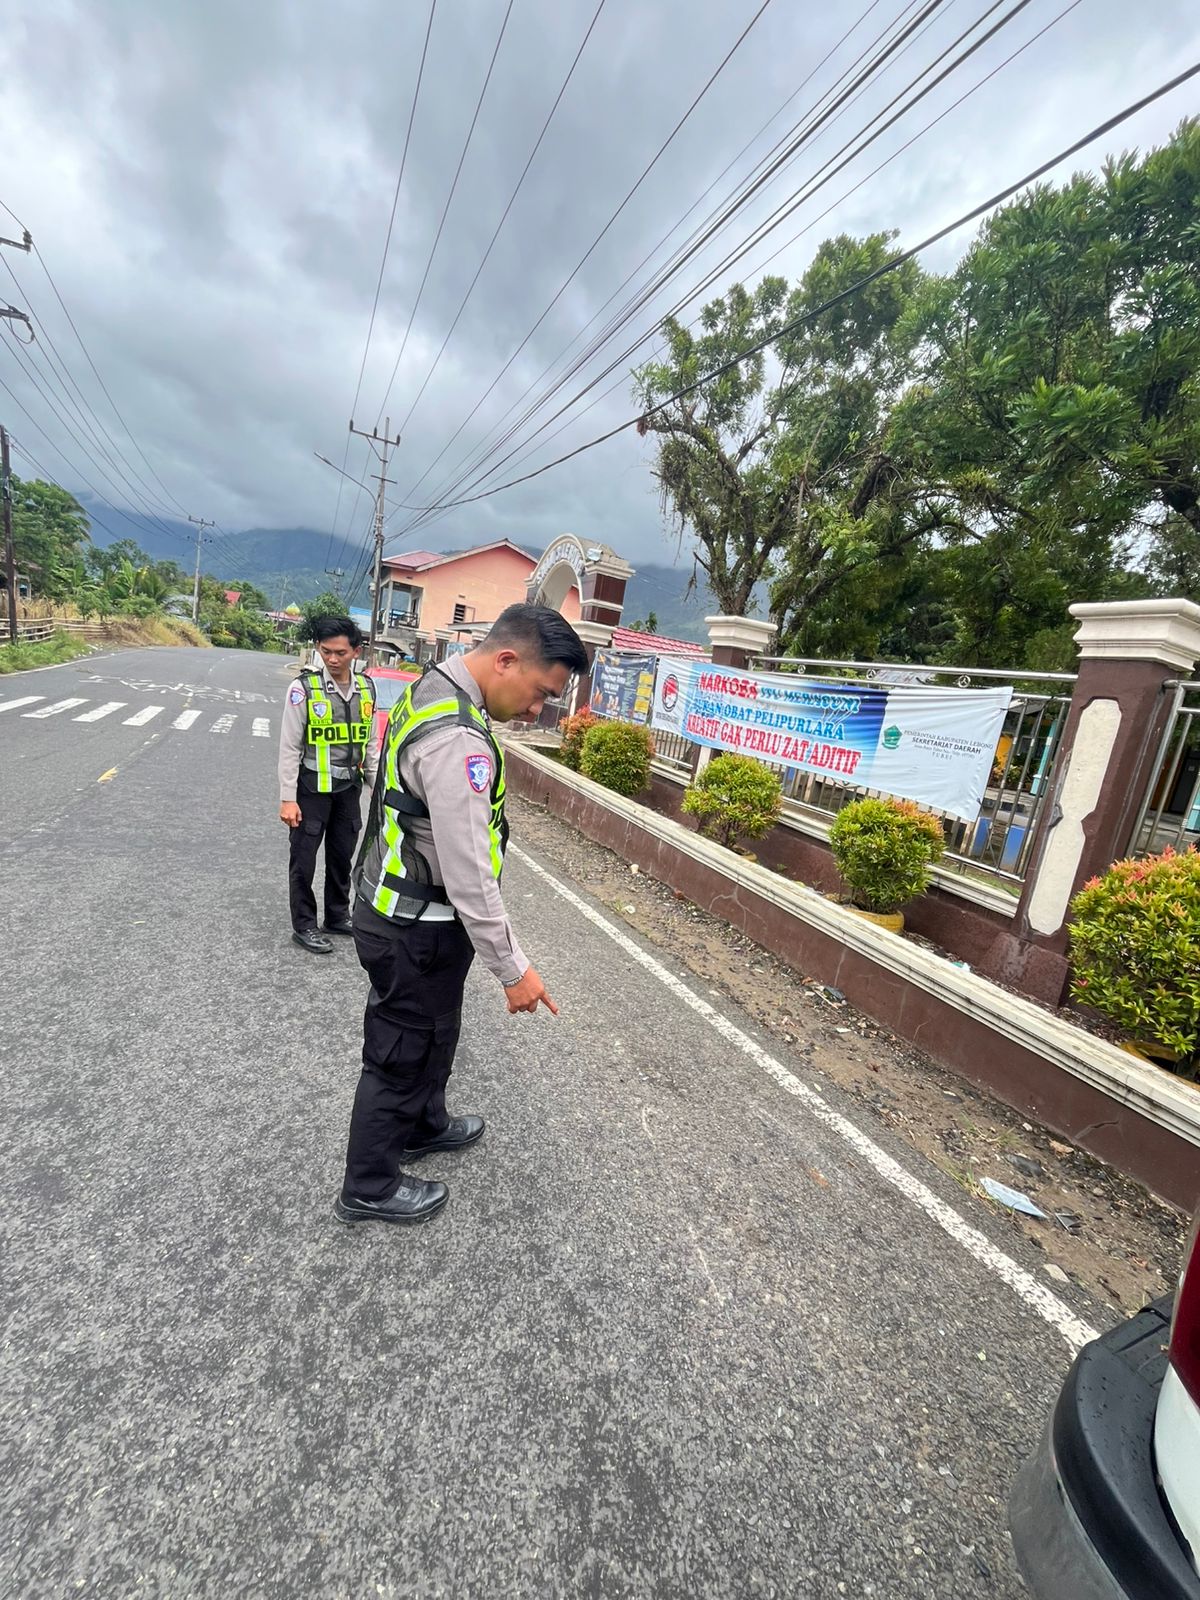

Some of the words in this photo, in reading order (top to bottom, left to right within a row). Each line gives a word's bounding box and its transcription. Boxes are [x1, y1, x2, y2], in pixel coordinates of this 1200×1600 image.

[699, 672, 758, 699] NARKOBA
[724, 703, 753, 721] OBAT
[754, 709, 844, 740] PELIPURLARA
[686, 714, 720, 738] KREATIF
[720, 721, 742, 747] GAK
[743, 729, 782, 756] PERLU
[781, 736, 809, 762] ZAT
[808, 742, 862, 775] ADITIF
[911, 737, 953, 748] SEKRETARIAT
[953, 744, 981, 754] DAERAH
[970, 741, 994, 750] LEBONG
